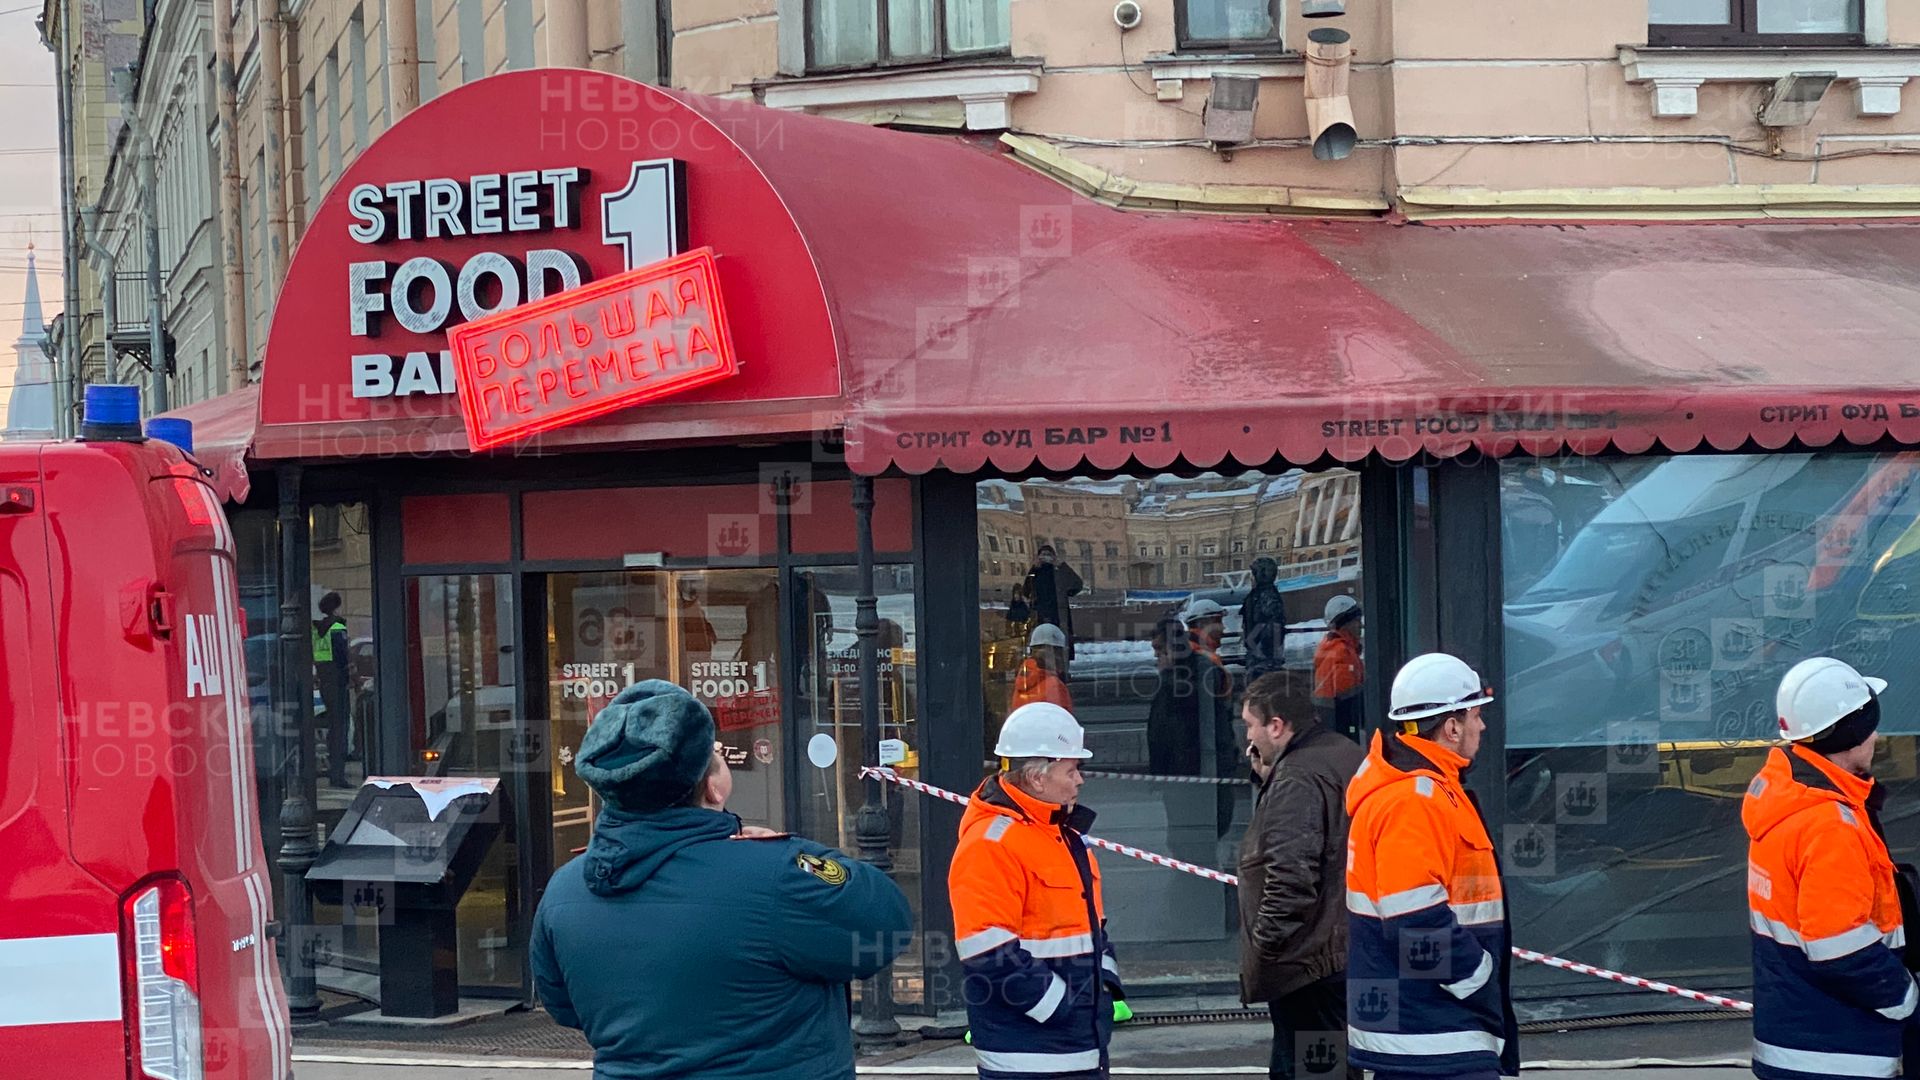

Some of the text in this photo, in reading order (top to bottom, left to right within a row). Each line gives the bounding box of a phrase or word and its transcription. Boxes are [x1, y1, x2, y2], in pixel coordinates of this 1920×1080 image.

[347, 166, 582, 244] STREET
[348, 248, 584, 336] FOOD
[471, 274, 703, 379] БОЛЬШАЯ
[479, 325, 716, 422] ПЕРЕМЕНА
[1760, 404, 1830, 423] СТРИТ
[1841, 403, 1889, 421] ФУД
[896, 422, 1173, 449] СТРИТ ФУД БАР №1
[1321, 418, 1402, 438] STREET
[1415, 415, 1480, 435] FOOD
[563, 662, 618, 678] STREET
[691, 661, 749, 677] STREET
[563, 680, 618, 698] FOOD
[692, 680, 749, 698] FOOD
